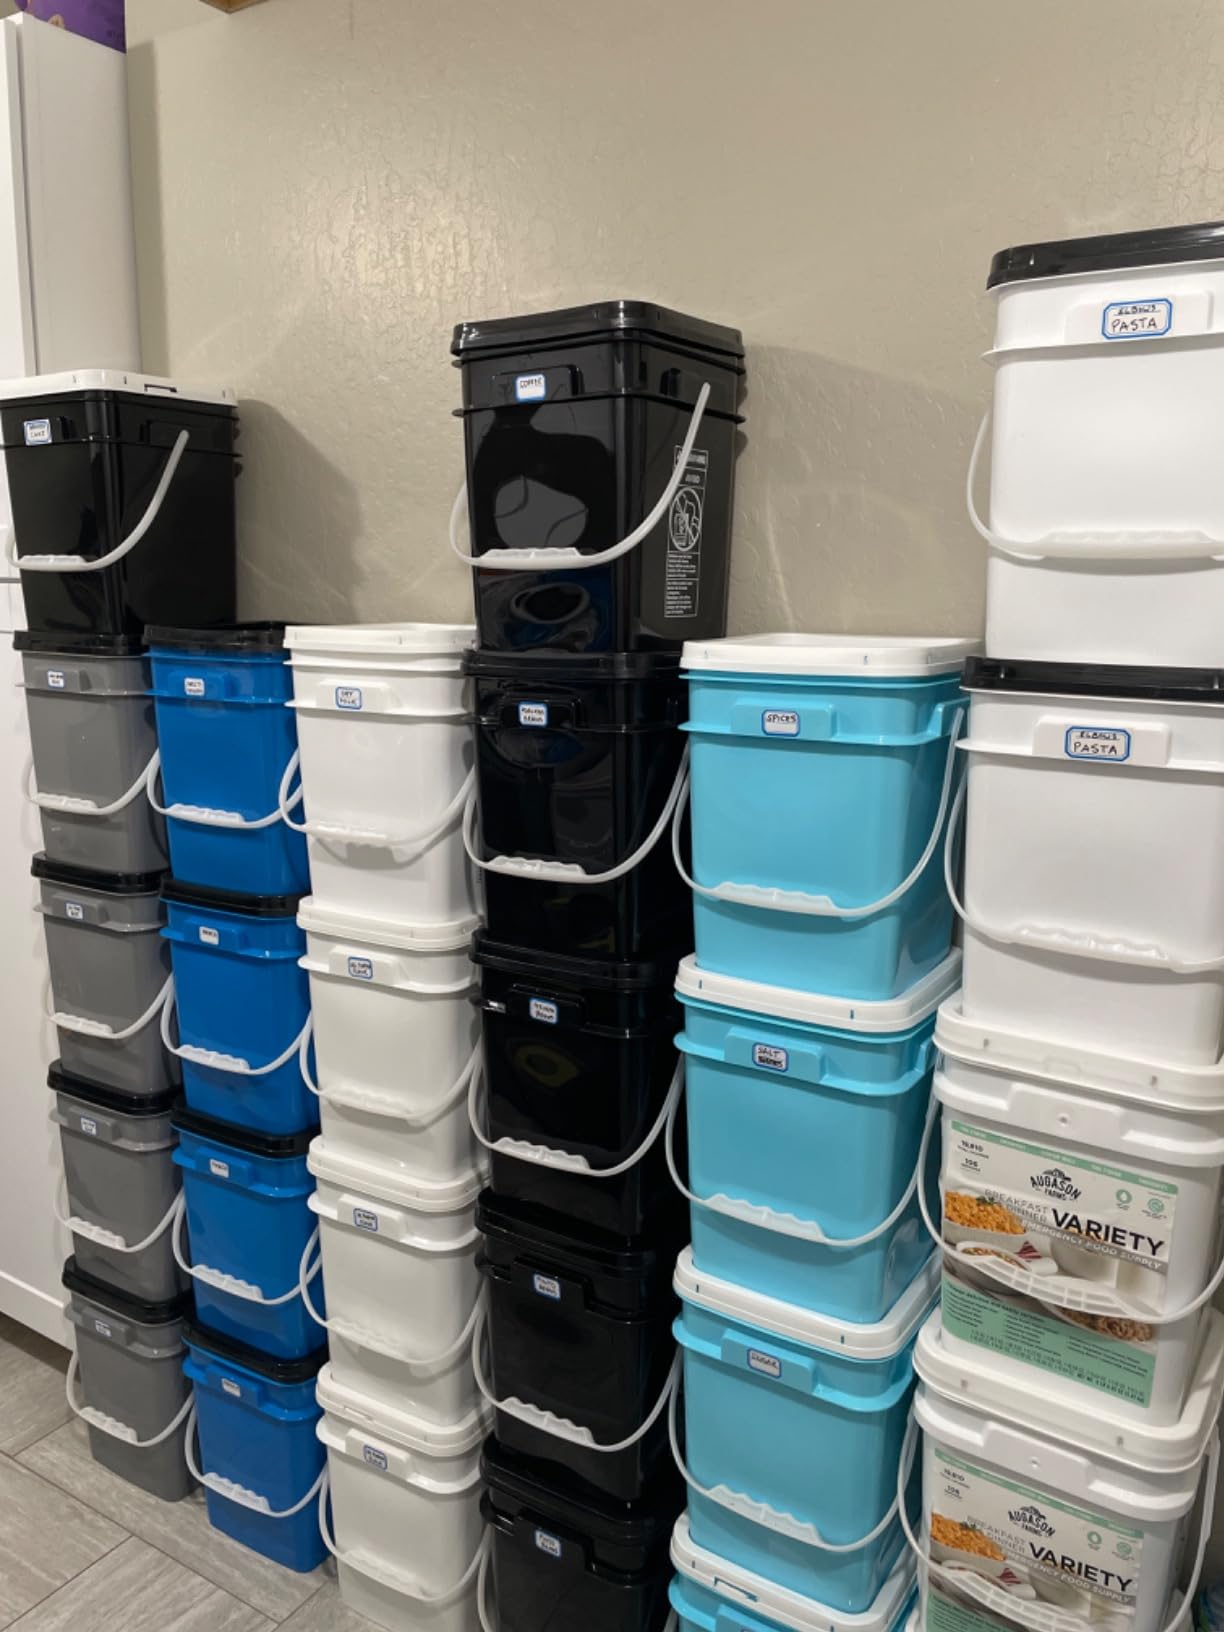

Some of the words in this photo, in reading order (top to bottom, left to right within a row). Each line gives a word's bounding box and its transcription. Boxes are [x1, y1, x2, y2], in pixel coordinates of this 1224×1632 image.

[1112, 317, 1157, 332] PASTA
[1073, 741, 1118, 755] PASTA
[1030, 1175, 1081, 1200] AUGASON
[1052, 1208, 1164, 1256] VARIETY
[1008, 1510, 1055, 1537] AUGASON
[1029, 1541, 1132, 1591] VARIETY
